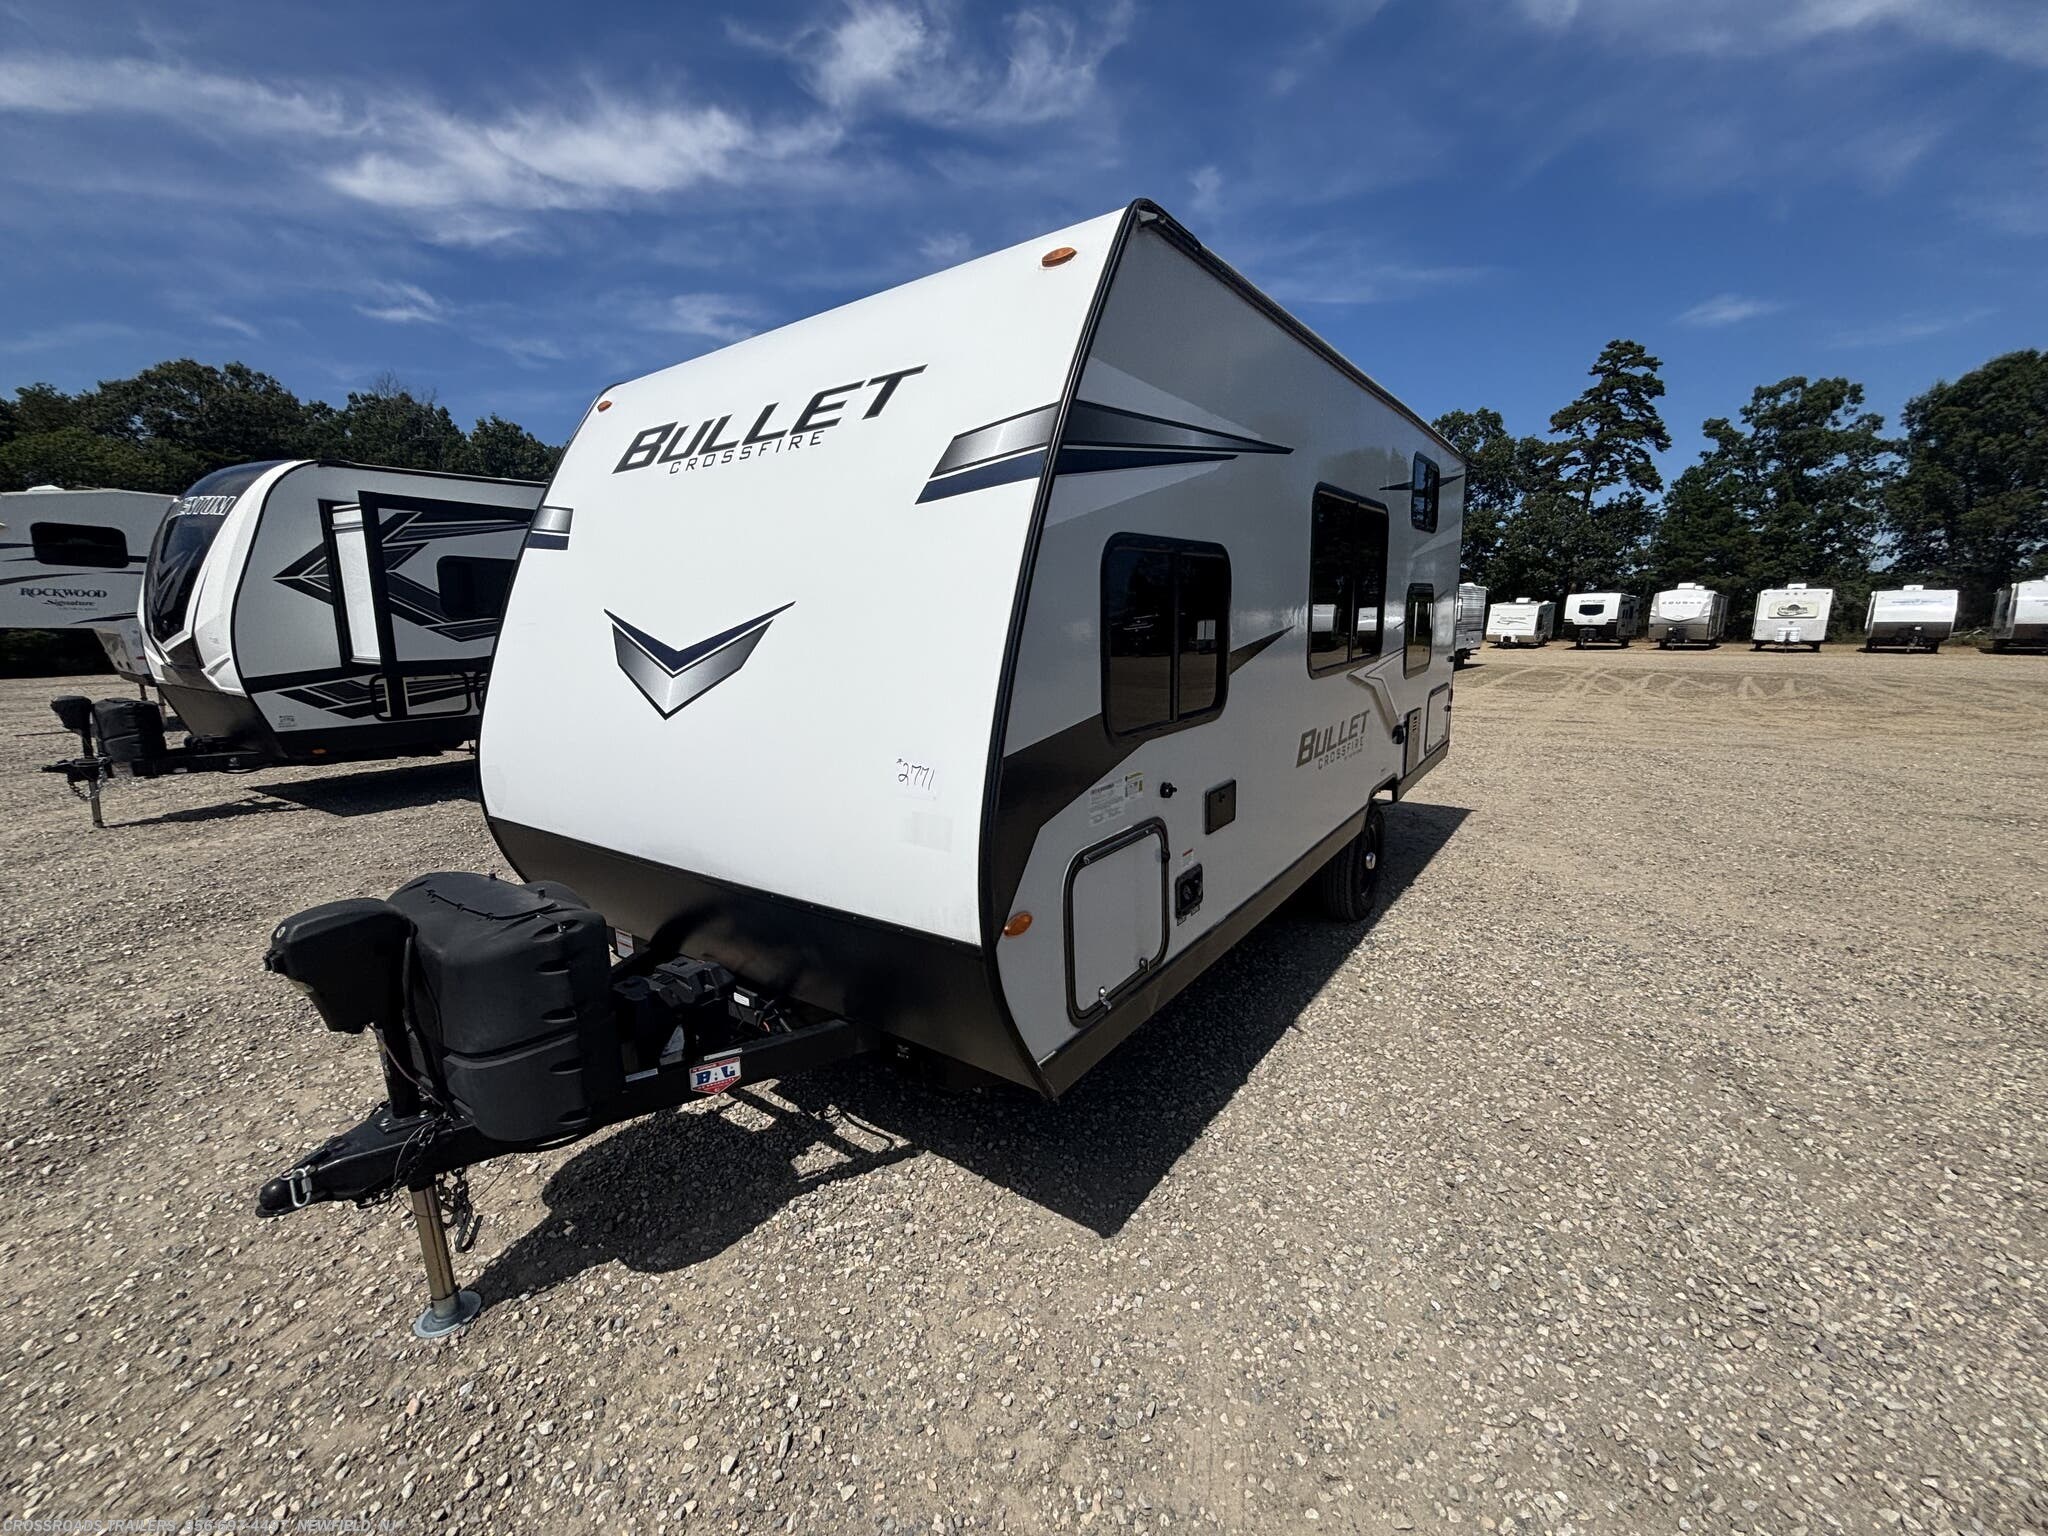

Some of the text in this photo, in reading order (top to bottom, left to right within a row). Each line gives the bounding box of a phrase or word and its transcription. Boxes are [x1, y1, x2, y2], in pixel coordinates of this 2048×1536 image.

[613, 364, 928, 474] BULLET
[669, 430, 824, 475] CROSSFIRE
[19, 587, 108, 598] ROCKWOOD
[1296, 709, 1370, 768] BULLET
[1317, 736, 1364, 770] CROSSFIRE
